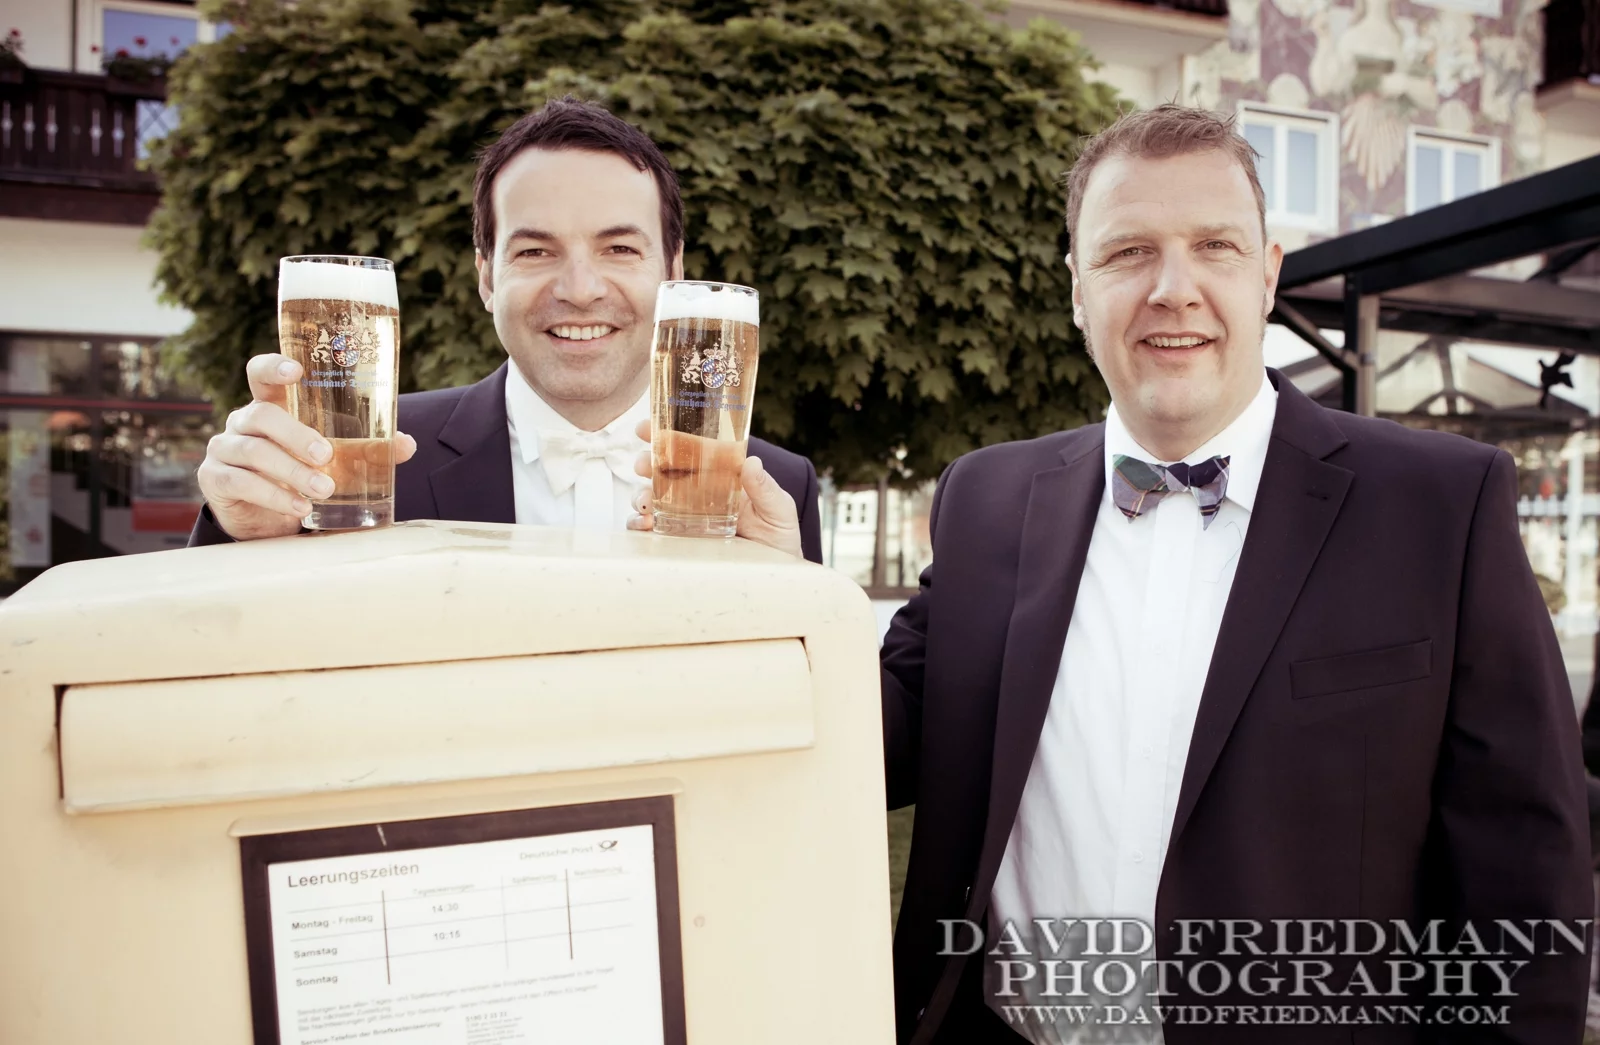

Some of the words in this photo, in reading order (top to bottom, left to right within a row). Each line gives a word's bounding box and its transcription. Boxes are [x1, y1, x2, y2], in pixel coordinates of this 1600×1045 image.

[520, 848, 569, 861] Deutsche
[571, 845, 594, 857] Post
[287, 863, 420, 888] Leerungszeiten
[291, 919, 329, 931] Montag
[338, 914, 374, 925] Freitag
[433, 930, 461, 942] 10:15
[293, 946, 338, 959] Samstag
[295, 975, 338, 987] Sonntag
